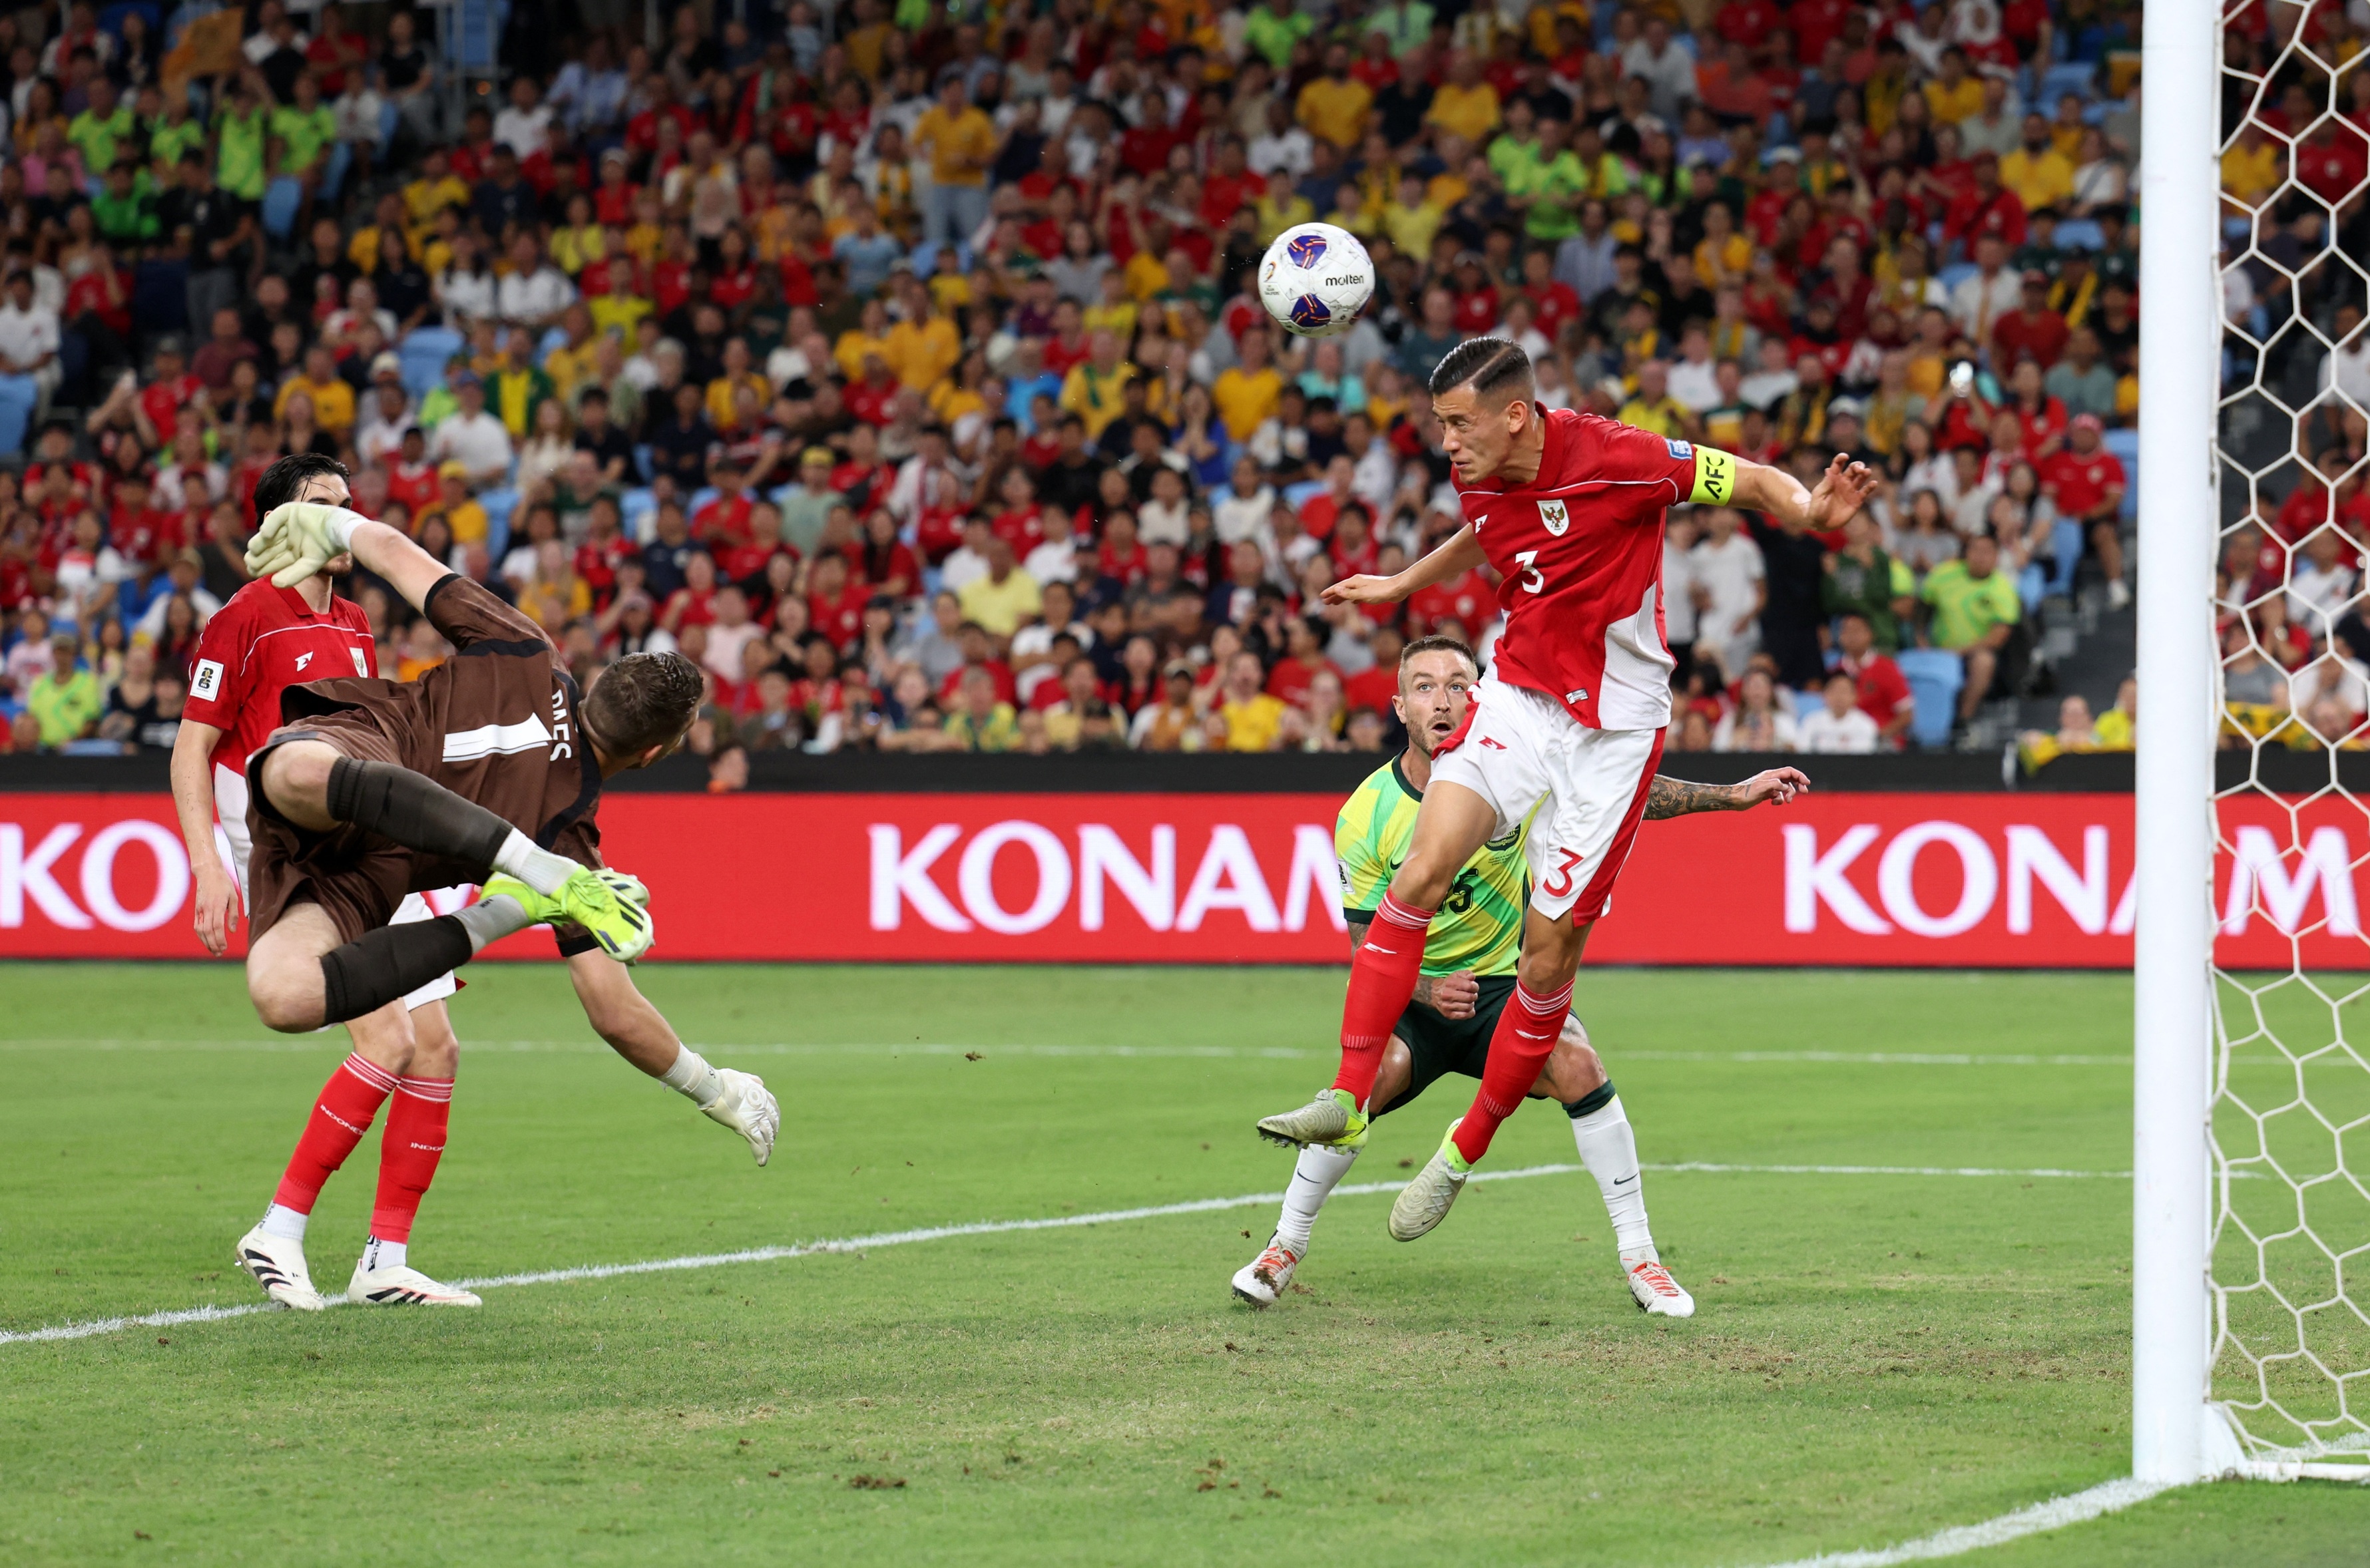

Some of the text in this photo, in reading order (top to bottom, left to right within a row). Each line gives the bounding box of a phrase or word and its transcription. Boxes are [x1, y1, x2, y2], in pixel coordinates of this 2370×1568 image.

[1325, 274, 1364, 286] molten
[1704, 456, 1724, 500] AFC
[1515, 550, 1544, 594] 3
[442, 711, 553, 762] 1
[1542, 847, 1584, 898] 3
[1781, 820, 2362, 937] KONM
